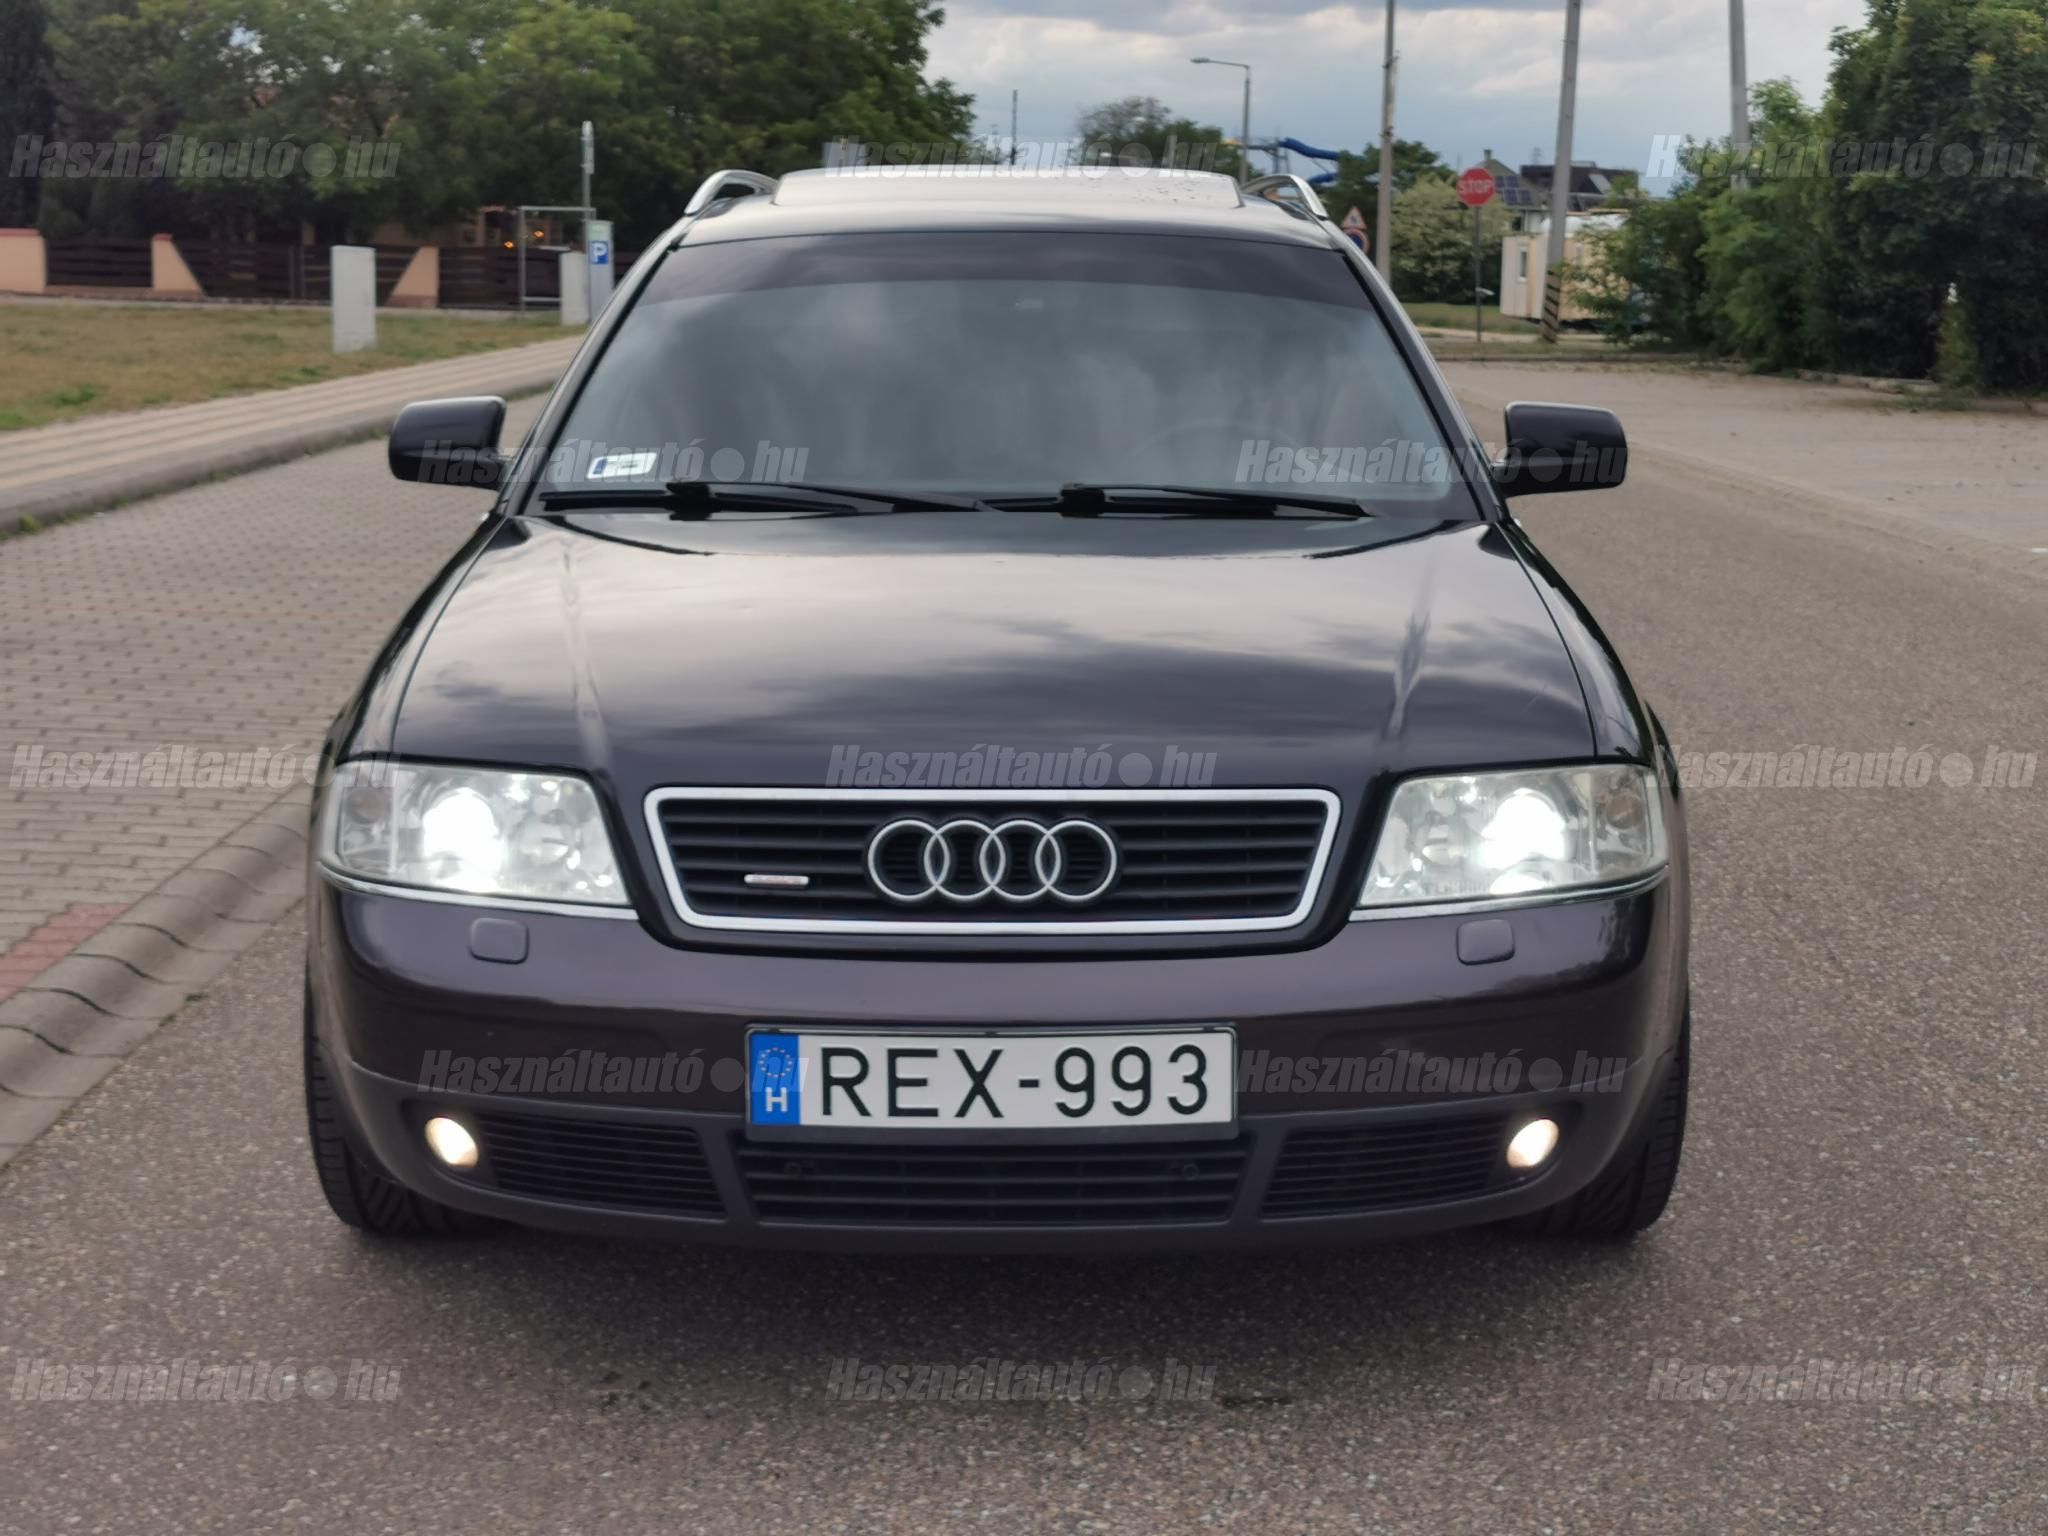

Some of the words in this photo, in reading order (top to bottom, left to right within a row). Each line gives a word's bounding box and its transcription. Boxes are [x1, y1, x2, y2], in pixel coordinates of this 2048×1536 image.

[1457, 179, 1494, 194] STOP
[821, 1044, 1208, 1118] REX-993
[765, 1087, 788, 1112] H
